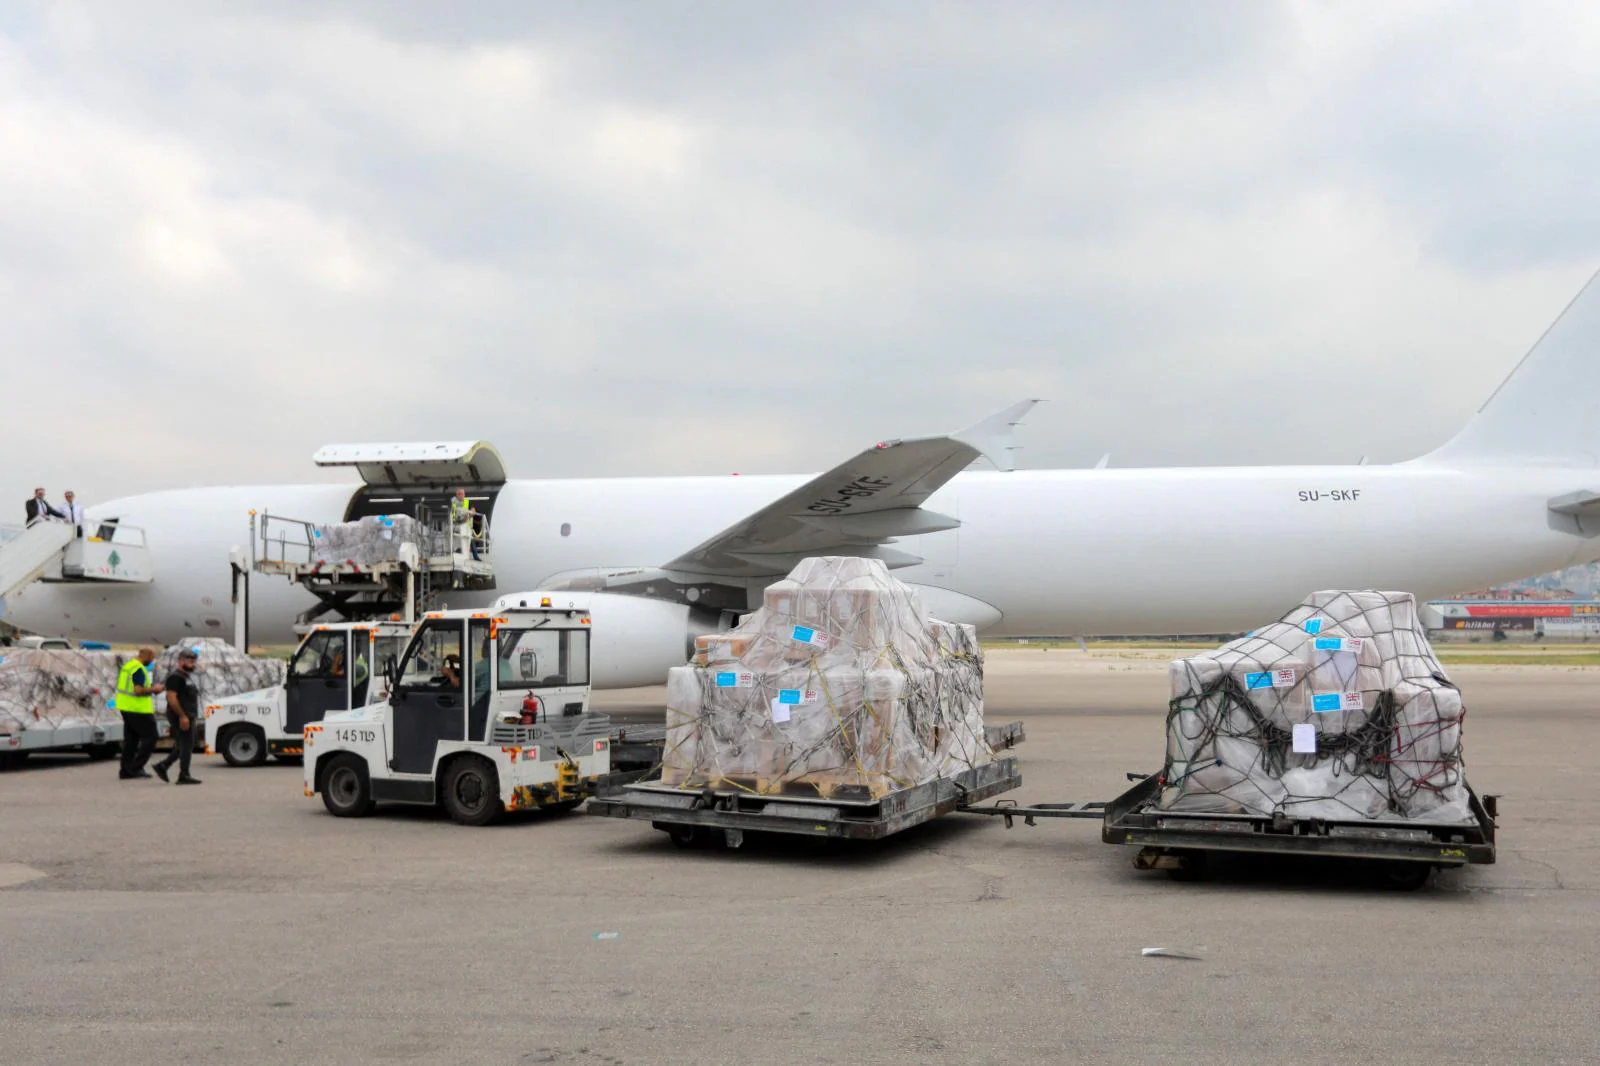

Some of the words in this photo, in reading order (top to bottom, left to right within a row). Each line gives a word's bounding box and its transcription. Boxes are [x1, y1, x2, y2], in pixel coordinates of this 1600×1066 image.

[807, 475, 892, 513] SU-SKF
[1298, 489, 1361, 502] SU-SKF
[336, 729, 358, 742] 145
[359, 730, 376, 742] TLD
